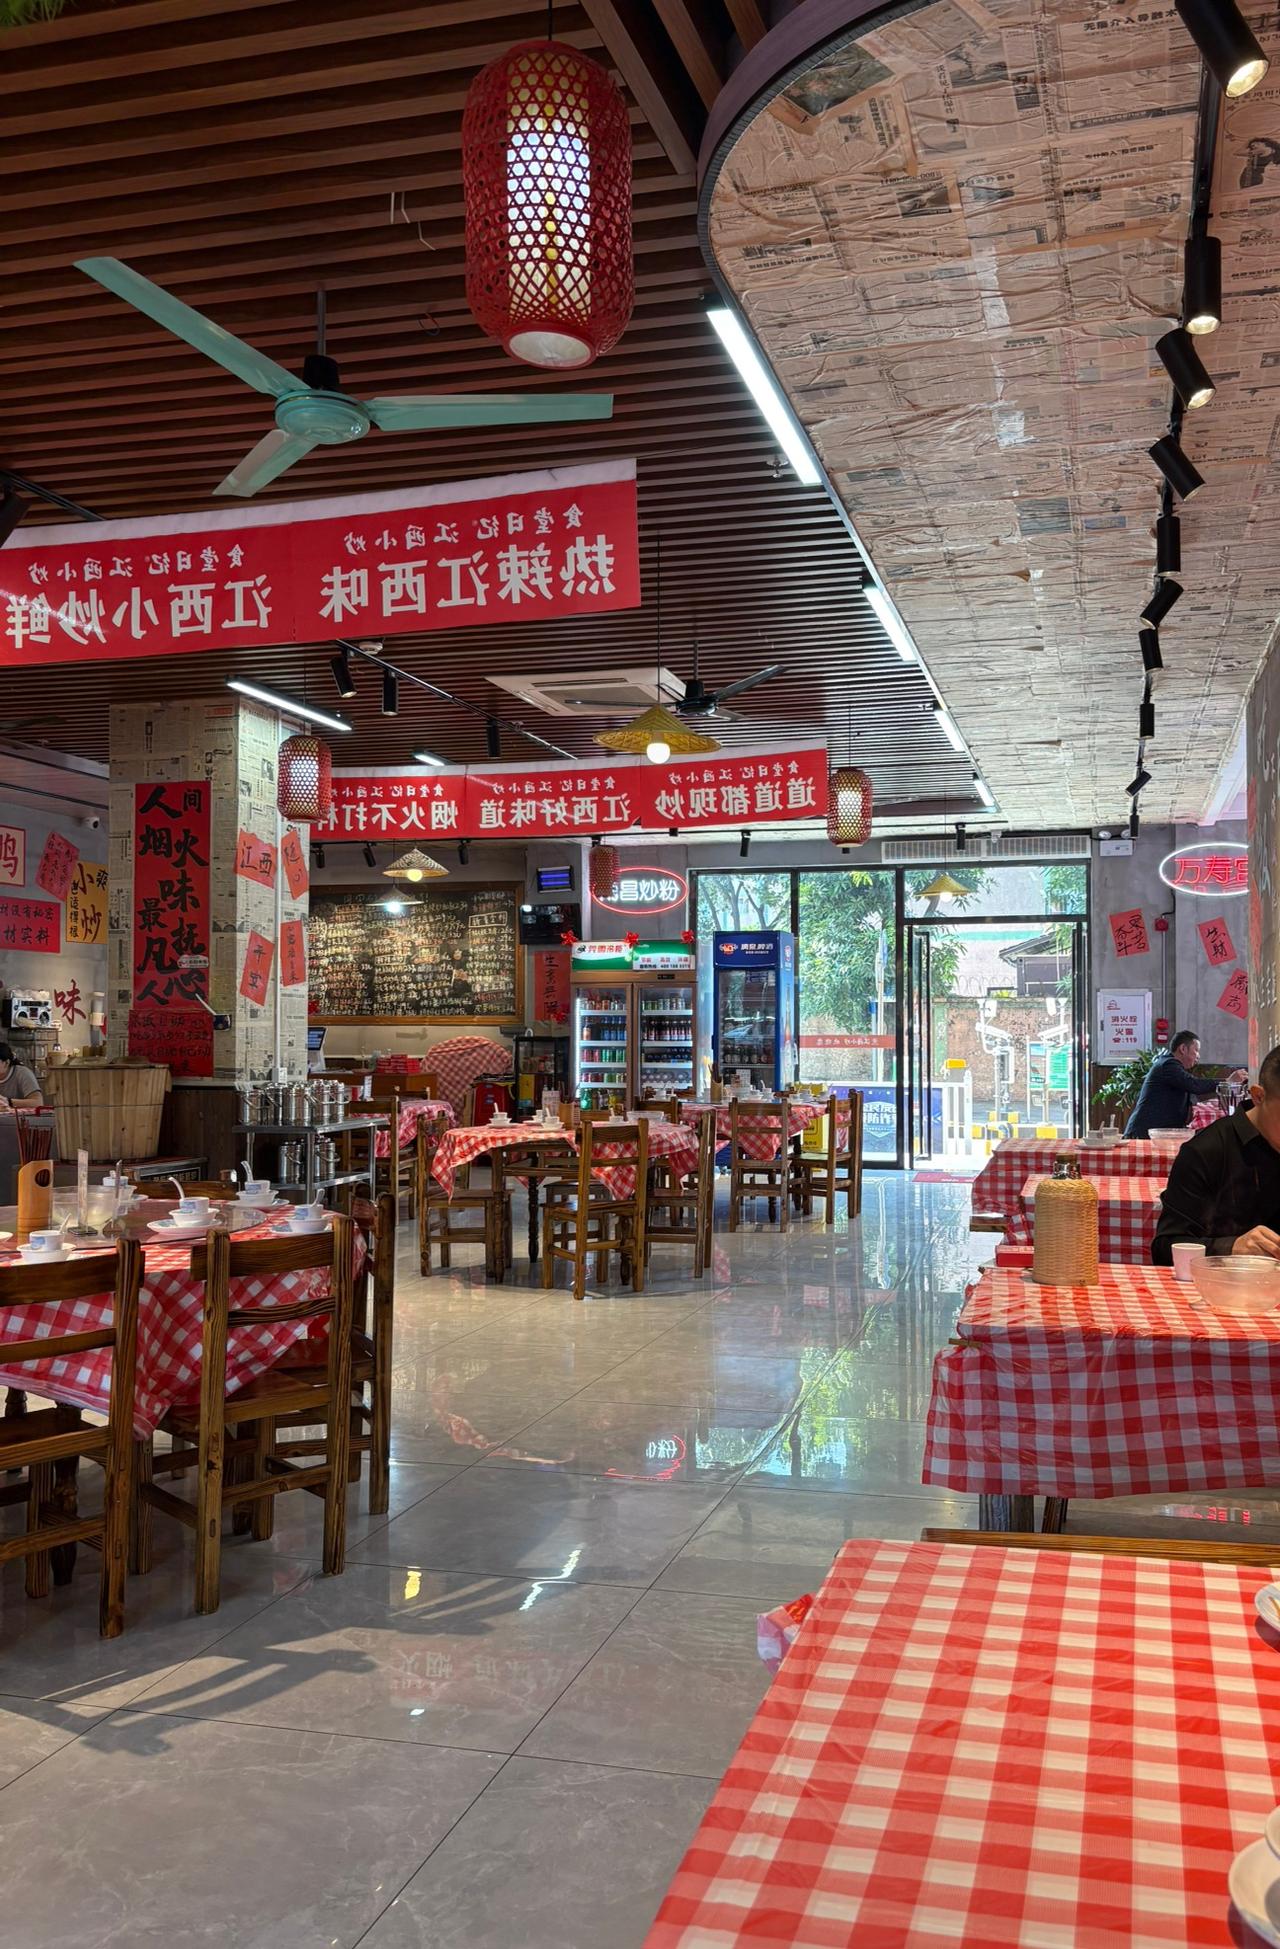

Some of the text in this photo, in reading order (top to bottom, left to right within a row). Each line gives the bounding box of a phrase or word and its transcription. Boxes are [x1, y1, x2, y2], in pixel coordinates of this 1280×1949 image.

[598, 879, 680, 902] 昌炒粉
[53, 977, 87, 1026] 味
